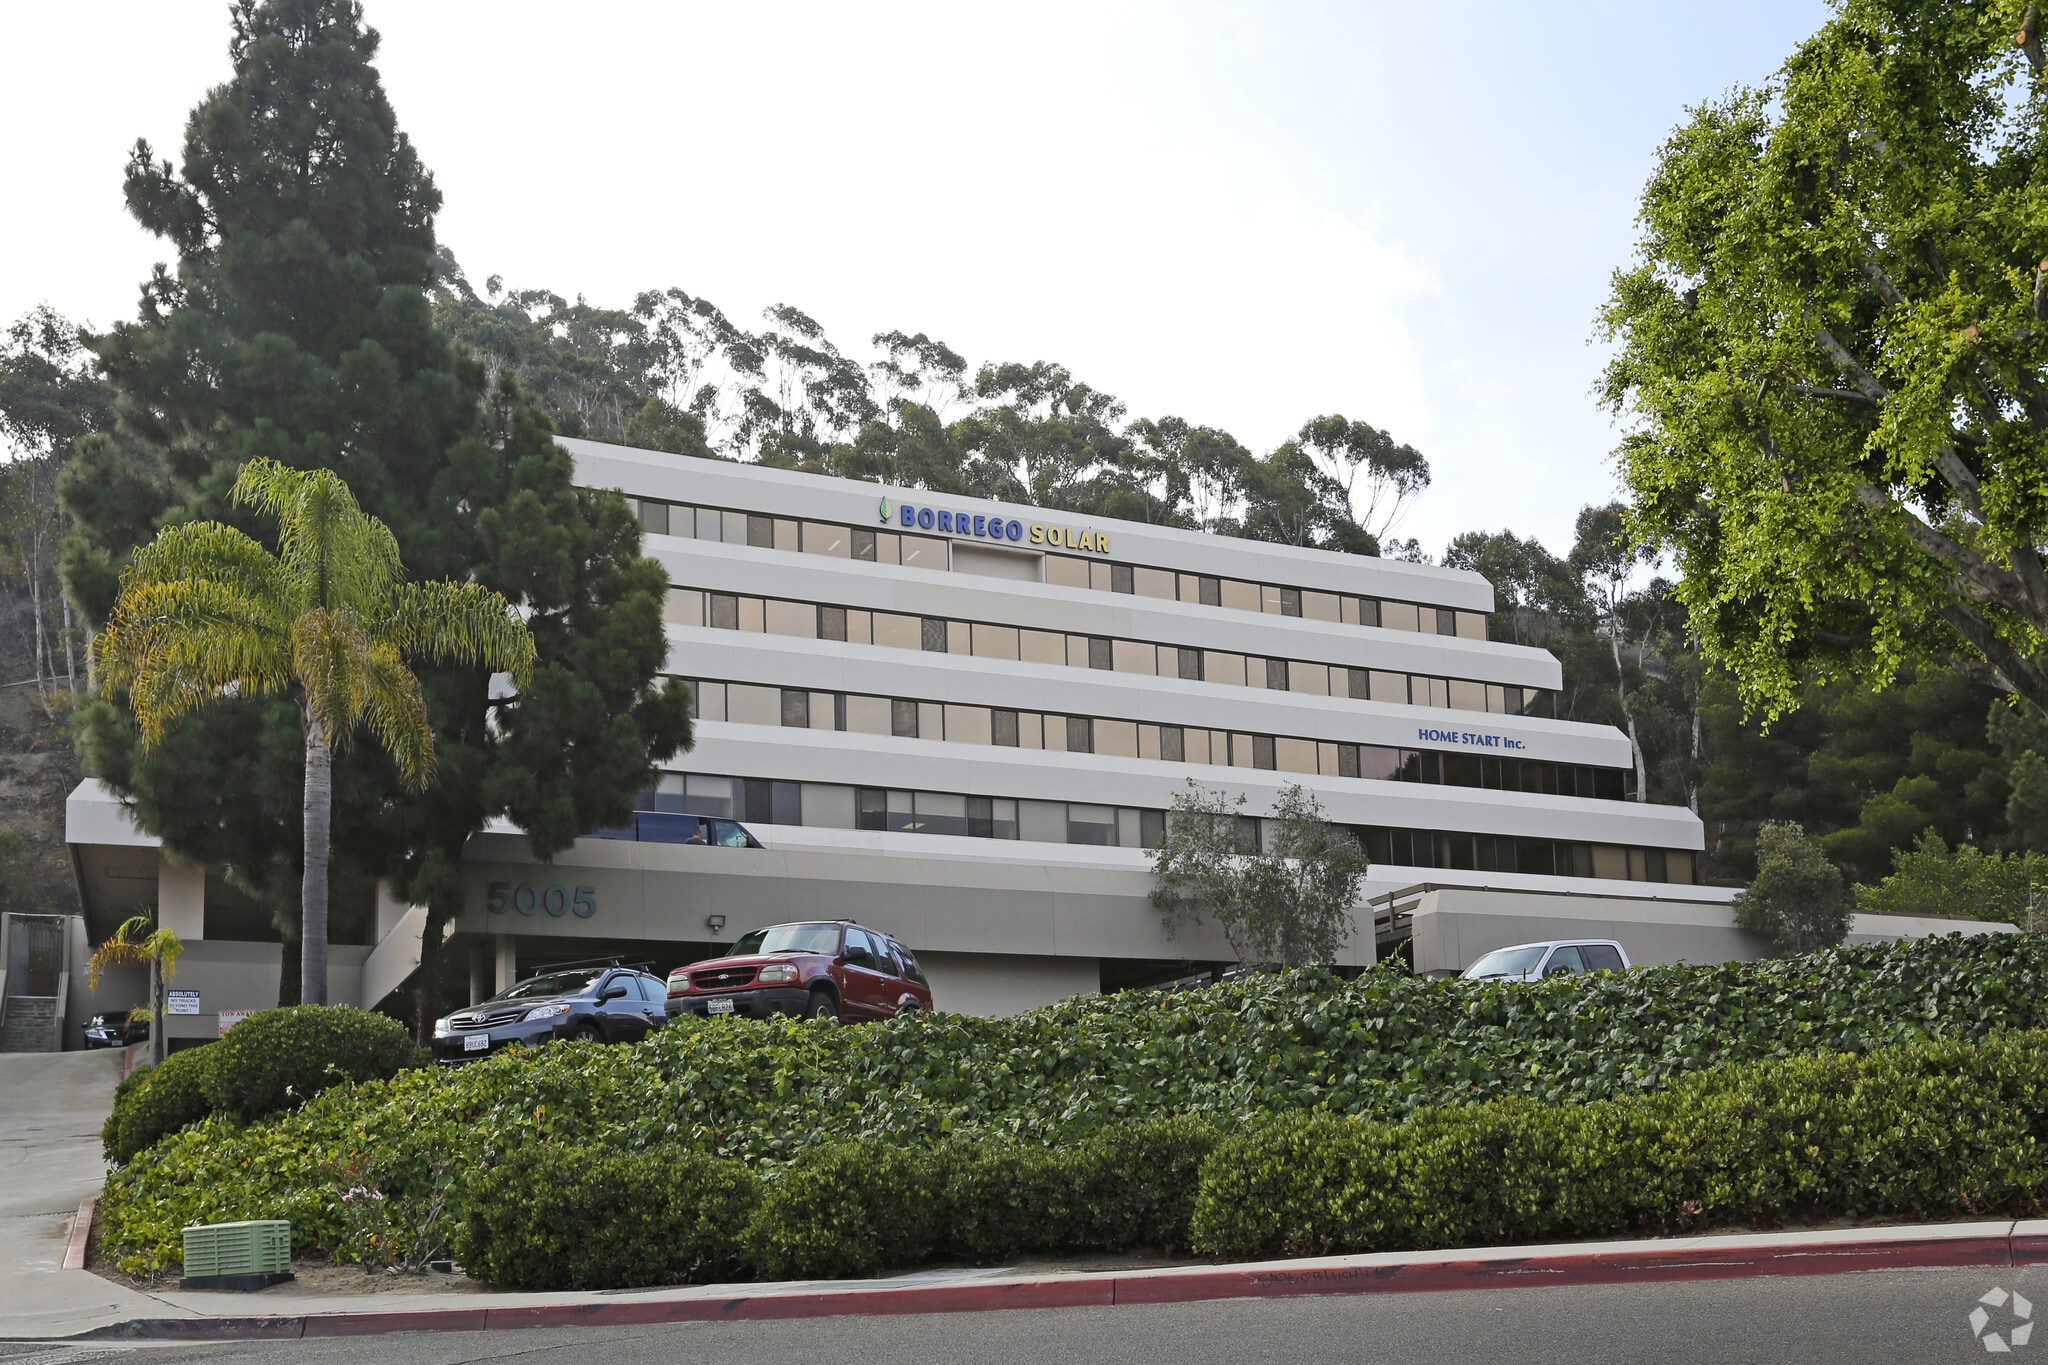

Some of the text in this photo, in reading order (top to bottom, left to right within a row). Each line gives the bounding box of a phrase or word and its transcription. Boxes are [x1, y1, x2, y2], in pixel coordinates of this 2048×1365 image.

[901, 505, 1110, 553] BORREGO SOLAR
[1418, 728, 1526, 749] HOME START Inc.
[487, 881, 597, 919] 5005
